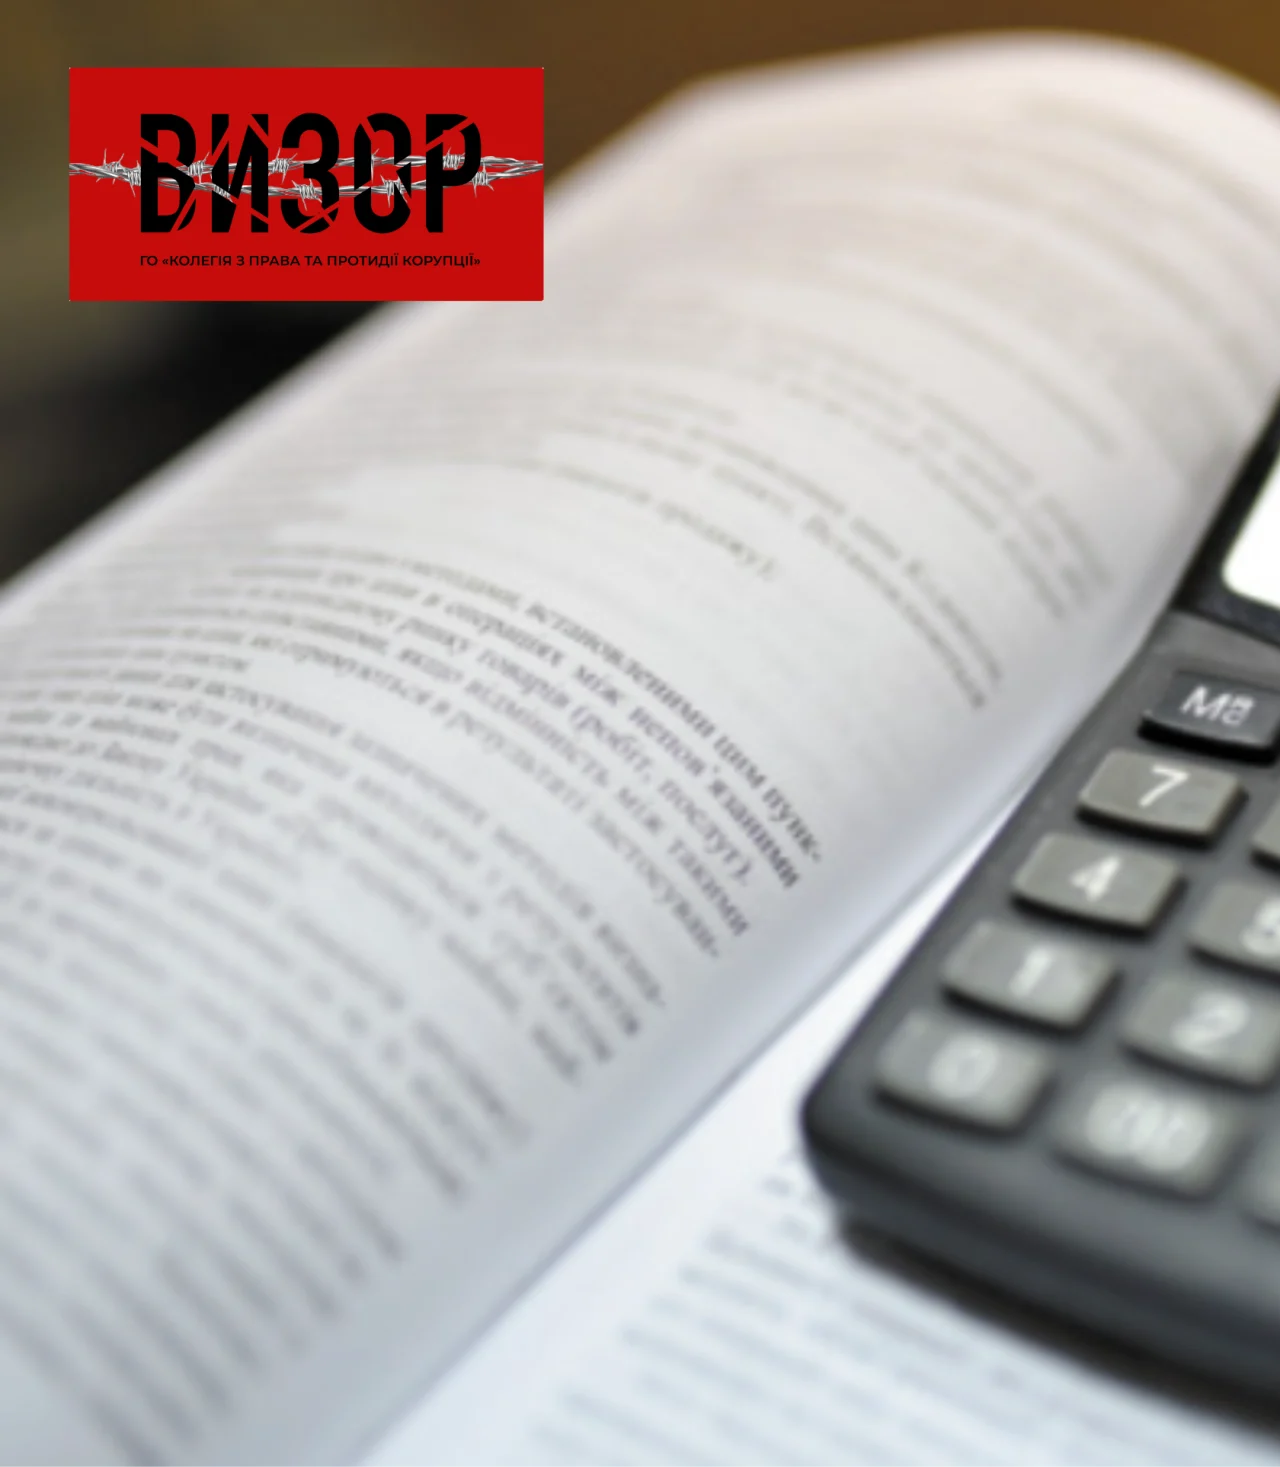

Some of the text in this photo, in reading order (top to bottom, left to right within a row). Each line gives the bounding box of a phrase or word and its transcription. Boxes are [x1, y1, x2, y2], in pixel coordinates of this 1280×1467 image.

[1136, 764, 1190, 807] 7
[1070, 854, 1123, 900] 4
[1009, 946, 1053, 999] 1
[1169, 992, 1249, 1056] 2
[928, 1036, 998, 1100] 0
